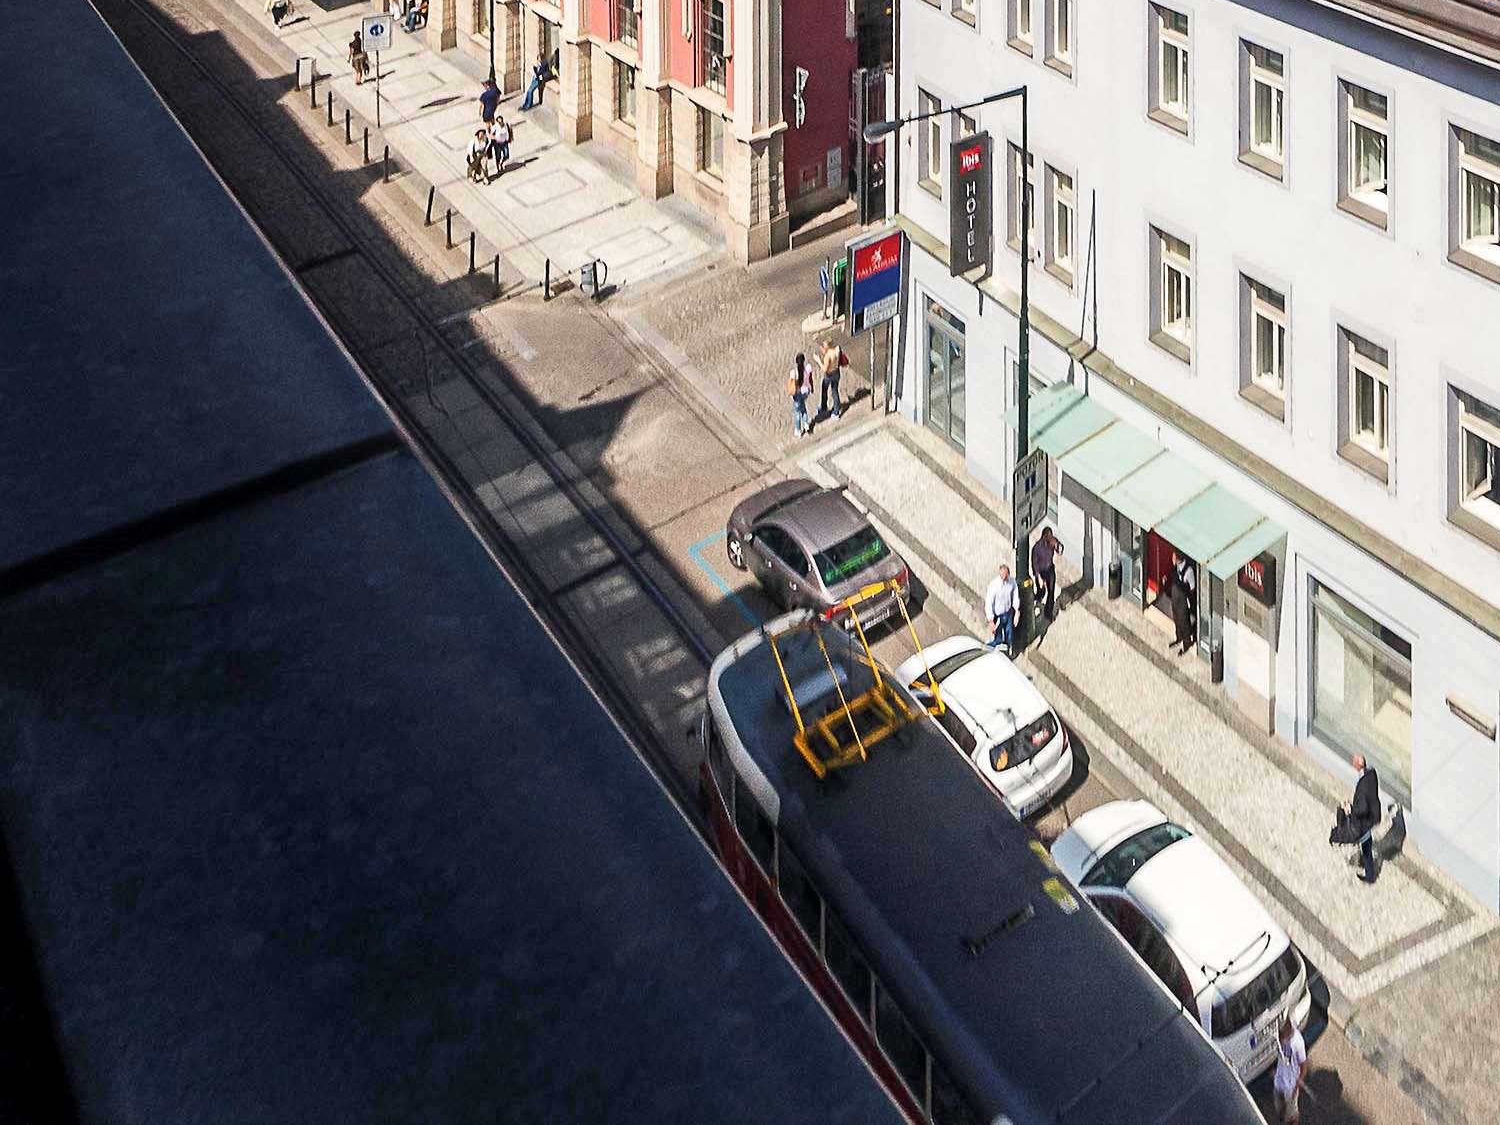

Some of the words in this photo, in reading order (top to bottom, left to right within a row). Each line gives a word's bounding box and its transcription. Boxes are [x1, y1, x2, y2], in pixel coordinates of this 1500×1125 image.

[963, 153, 979, 169] ibis
[966, 180, 976, 263] HOTEL
[1245, 562, 1262, 586] ibis
